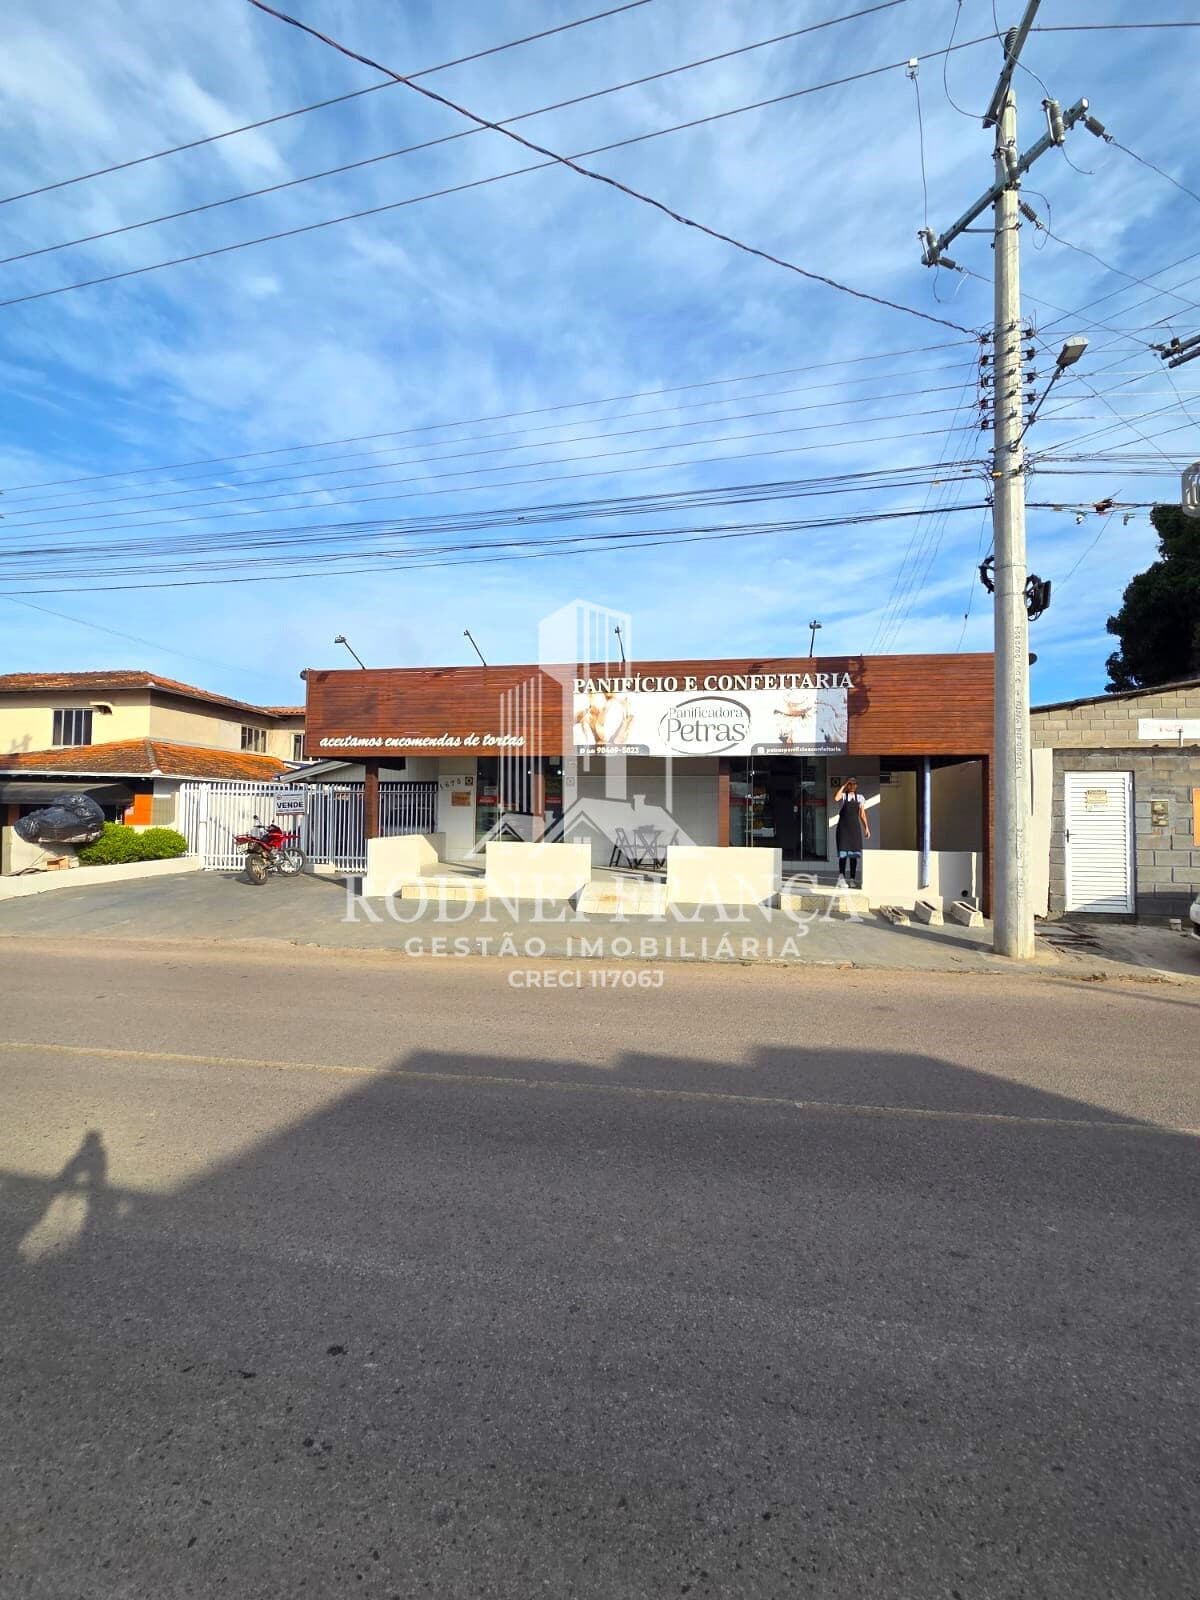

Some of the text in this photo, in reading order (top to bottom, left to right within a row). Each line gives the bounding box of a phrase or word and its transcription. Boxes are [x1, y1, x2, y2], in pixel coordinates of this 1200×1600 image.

[573, 672, 854, 694] PANIFÍCIO E CONFEITARIA
[669, 706, 743, 719] Panificadora
[667, 718, 745, 742] Petras
[319, 733, 525, 747] aceitamos encomendas de tortas
